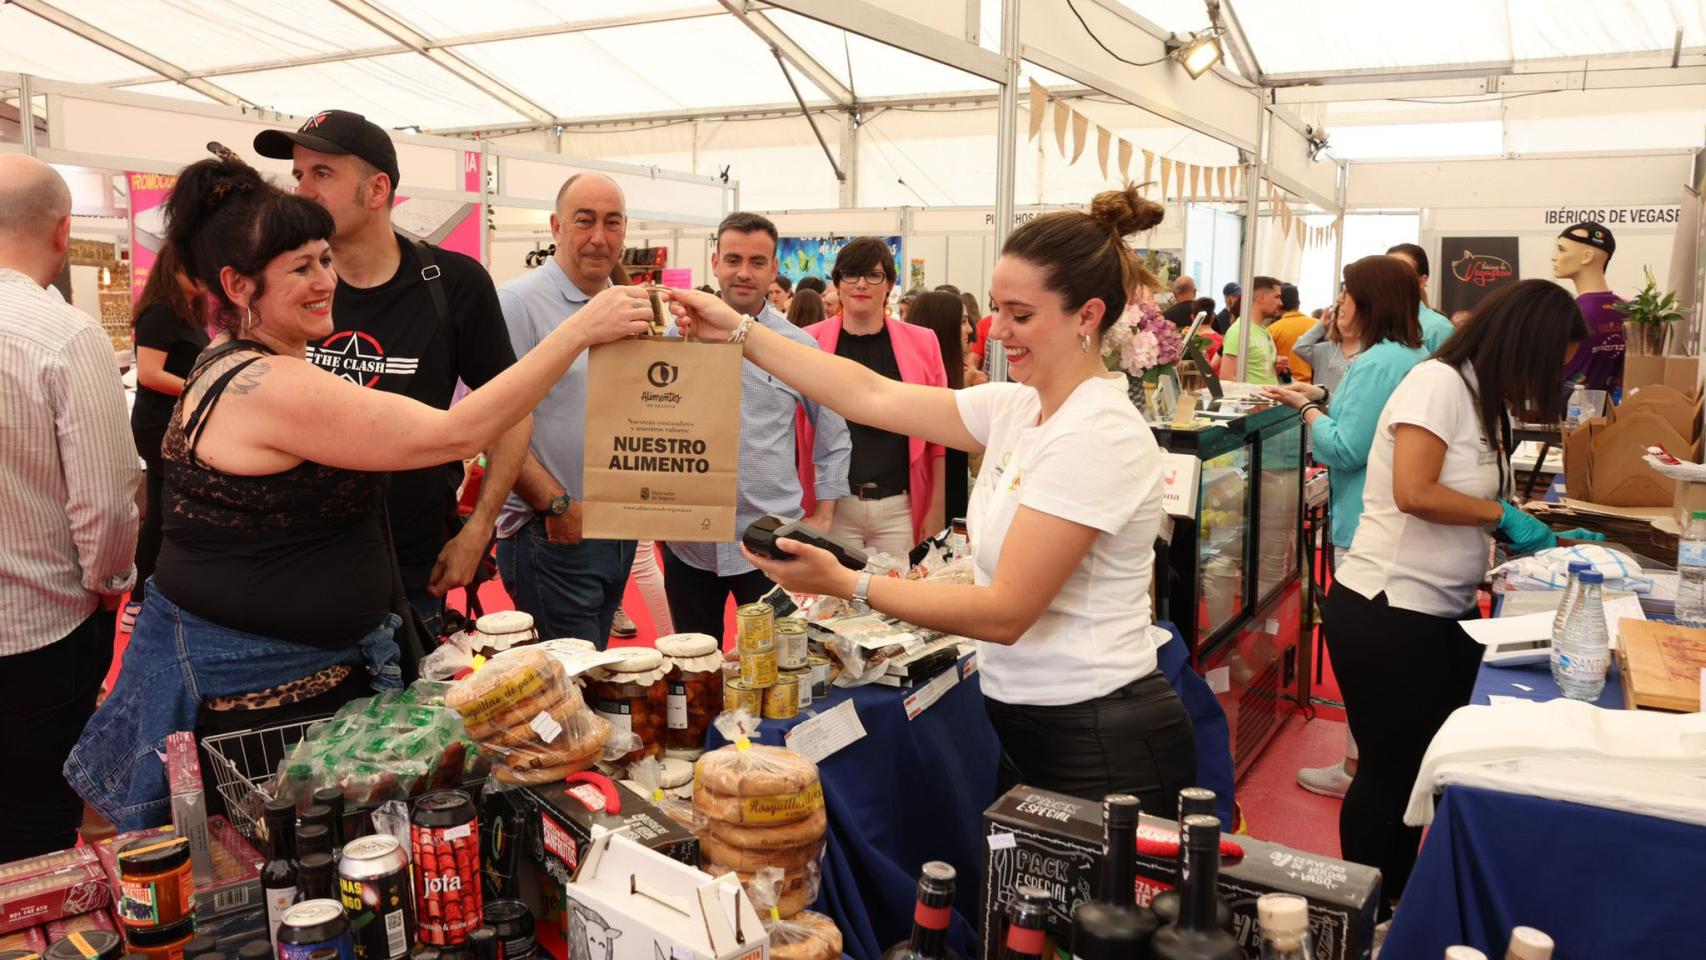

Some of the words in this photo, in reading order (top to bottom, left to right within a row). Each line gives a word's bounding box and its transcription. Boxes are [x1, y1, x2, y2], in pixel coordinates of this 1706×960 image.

[1545, 207, 1605, 224] IBÉRICOS
[1609, 209, 1627, 223] DE
[314, 353, 341, 368] THE
[343, 358, 385, 373] CLASH
[613, 436, 706, 455] NUESTRO
[608, 455, 710, 474] ALIMENTO
[1016, 801, 1071, 823] ESPECIAL
[1016, 848, 1070, 883] PACK
[1015, 872, 1068, 903] ESPECIAL
